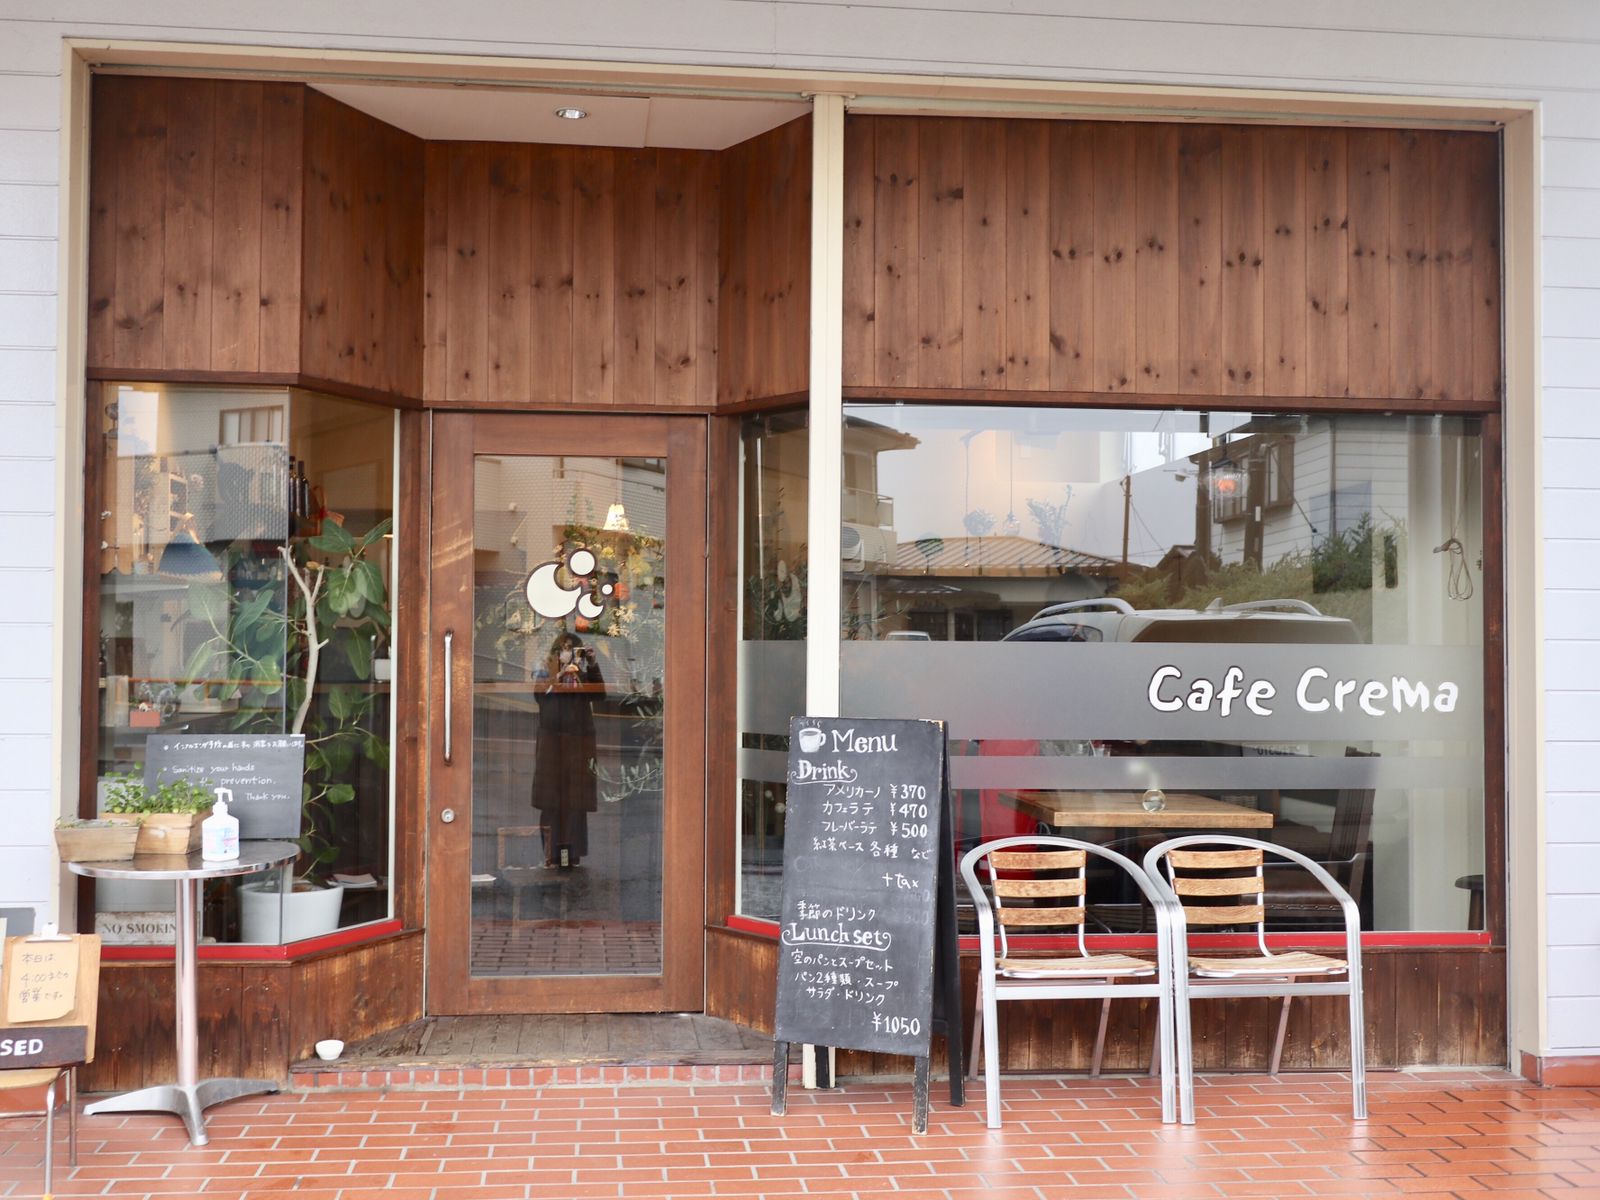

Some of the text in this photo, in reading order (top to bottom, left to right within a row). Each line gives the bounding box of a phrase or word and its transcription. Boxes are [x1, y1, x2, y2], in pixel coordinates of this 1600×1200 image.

[1148, 664, 1277, 717] Cafe
[831, 728, 899, 754] Menu
[172, 763, 255, 776] Sanitize your hands
[796, 759, 851, 781] Drink
[220, 776, 276, 787] prevention.
[246, 792, 269, 801] Thank
[823, 783, 927, 800] アメリカーノ ¥370
[822, 801, 928, 819] カフェラテ ¥470
[821, 820, 928, 838] フレーバーラテ ¥500
[797, 900, 876, 922] 季節のドリンク
[102, 923, 123, 935] NO
[791, 922, 884, 946] Lunch set
[21, 953, 56, 966] 本日は
[871, 1011, 921, 1036] ¥1050
